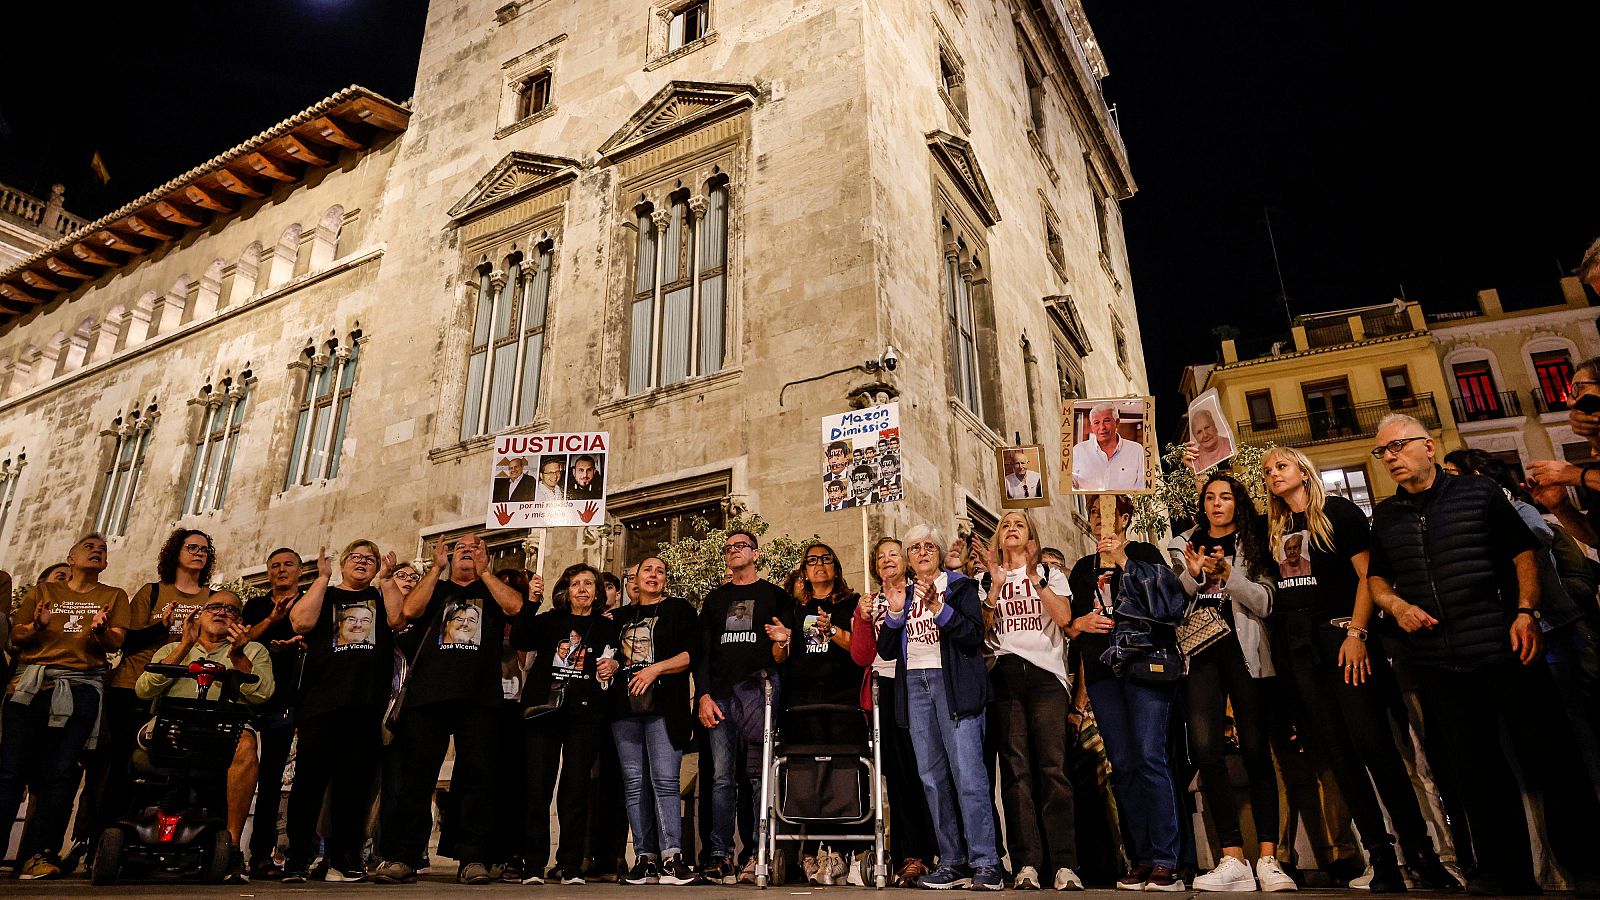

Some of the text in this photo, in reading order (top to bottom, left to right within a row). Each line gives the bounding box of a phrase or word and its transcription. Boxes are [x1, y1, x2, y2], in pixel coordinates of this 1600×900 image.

[497, 434, 606, 454] JUSTICIA
[1061, 406, 1072, 472] MAZÓN
[519, 503, 533, 511] por
[534, 501, 544, 509] mi
[524, 512, 530, 520] y
[1295, 576, 1318, 586] LUISA
[1005, 598, 1042, 617] OBLIT
[1006, 614, 1043, 633] PERDÓ
[720, 631, 757, 645] MANOLO
[333, 643, 349, 653] José
[454, 643, 479, 651] Vicente
